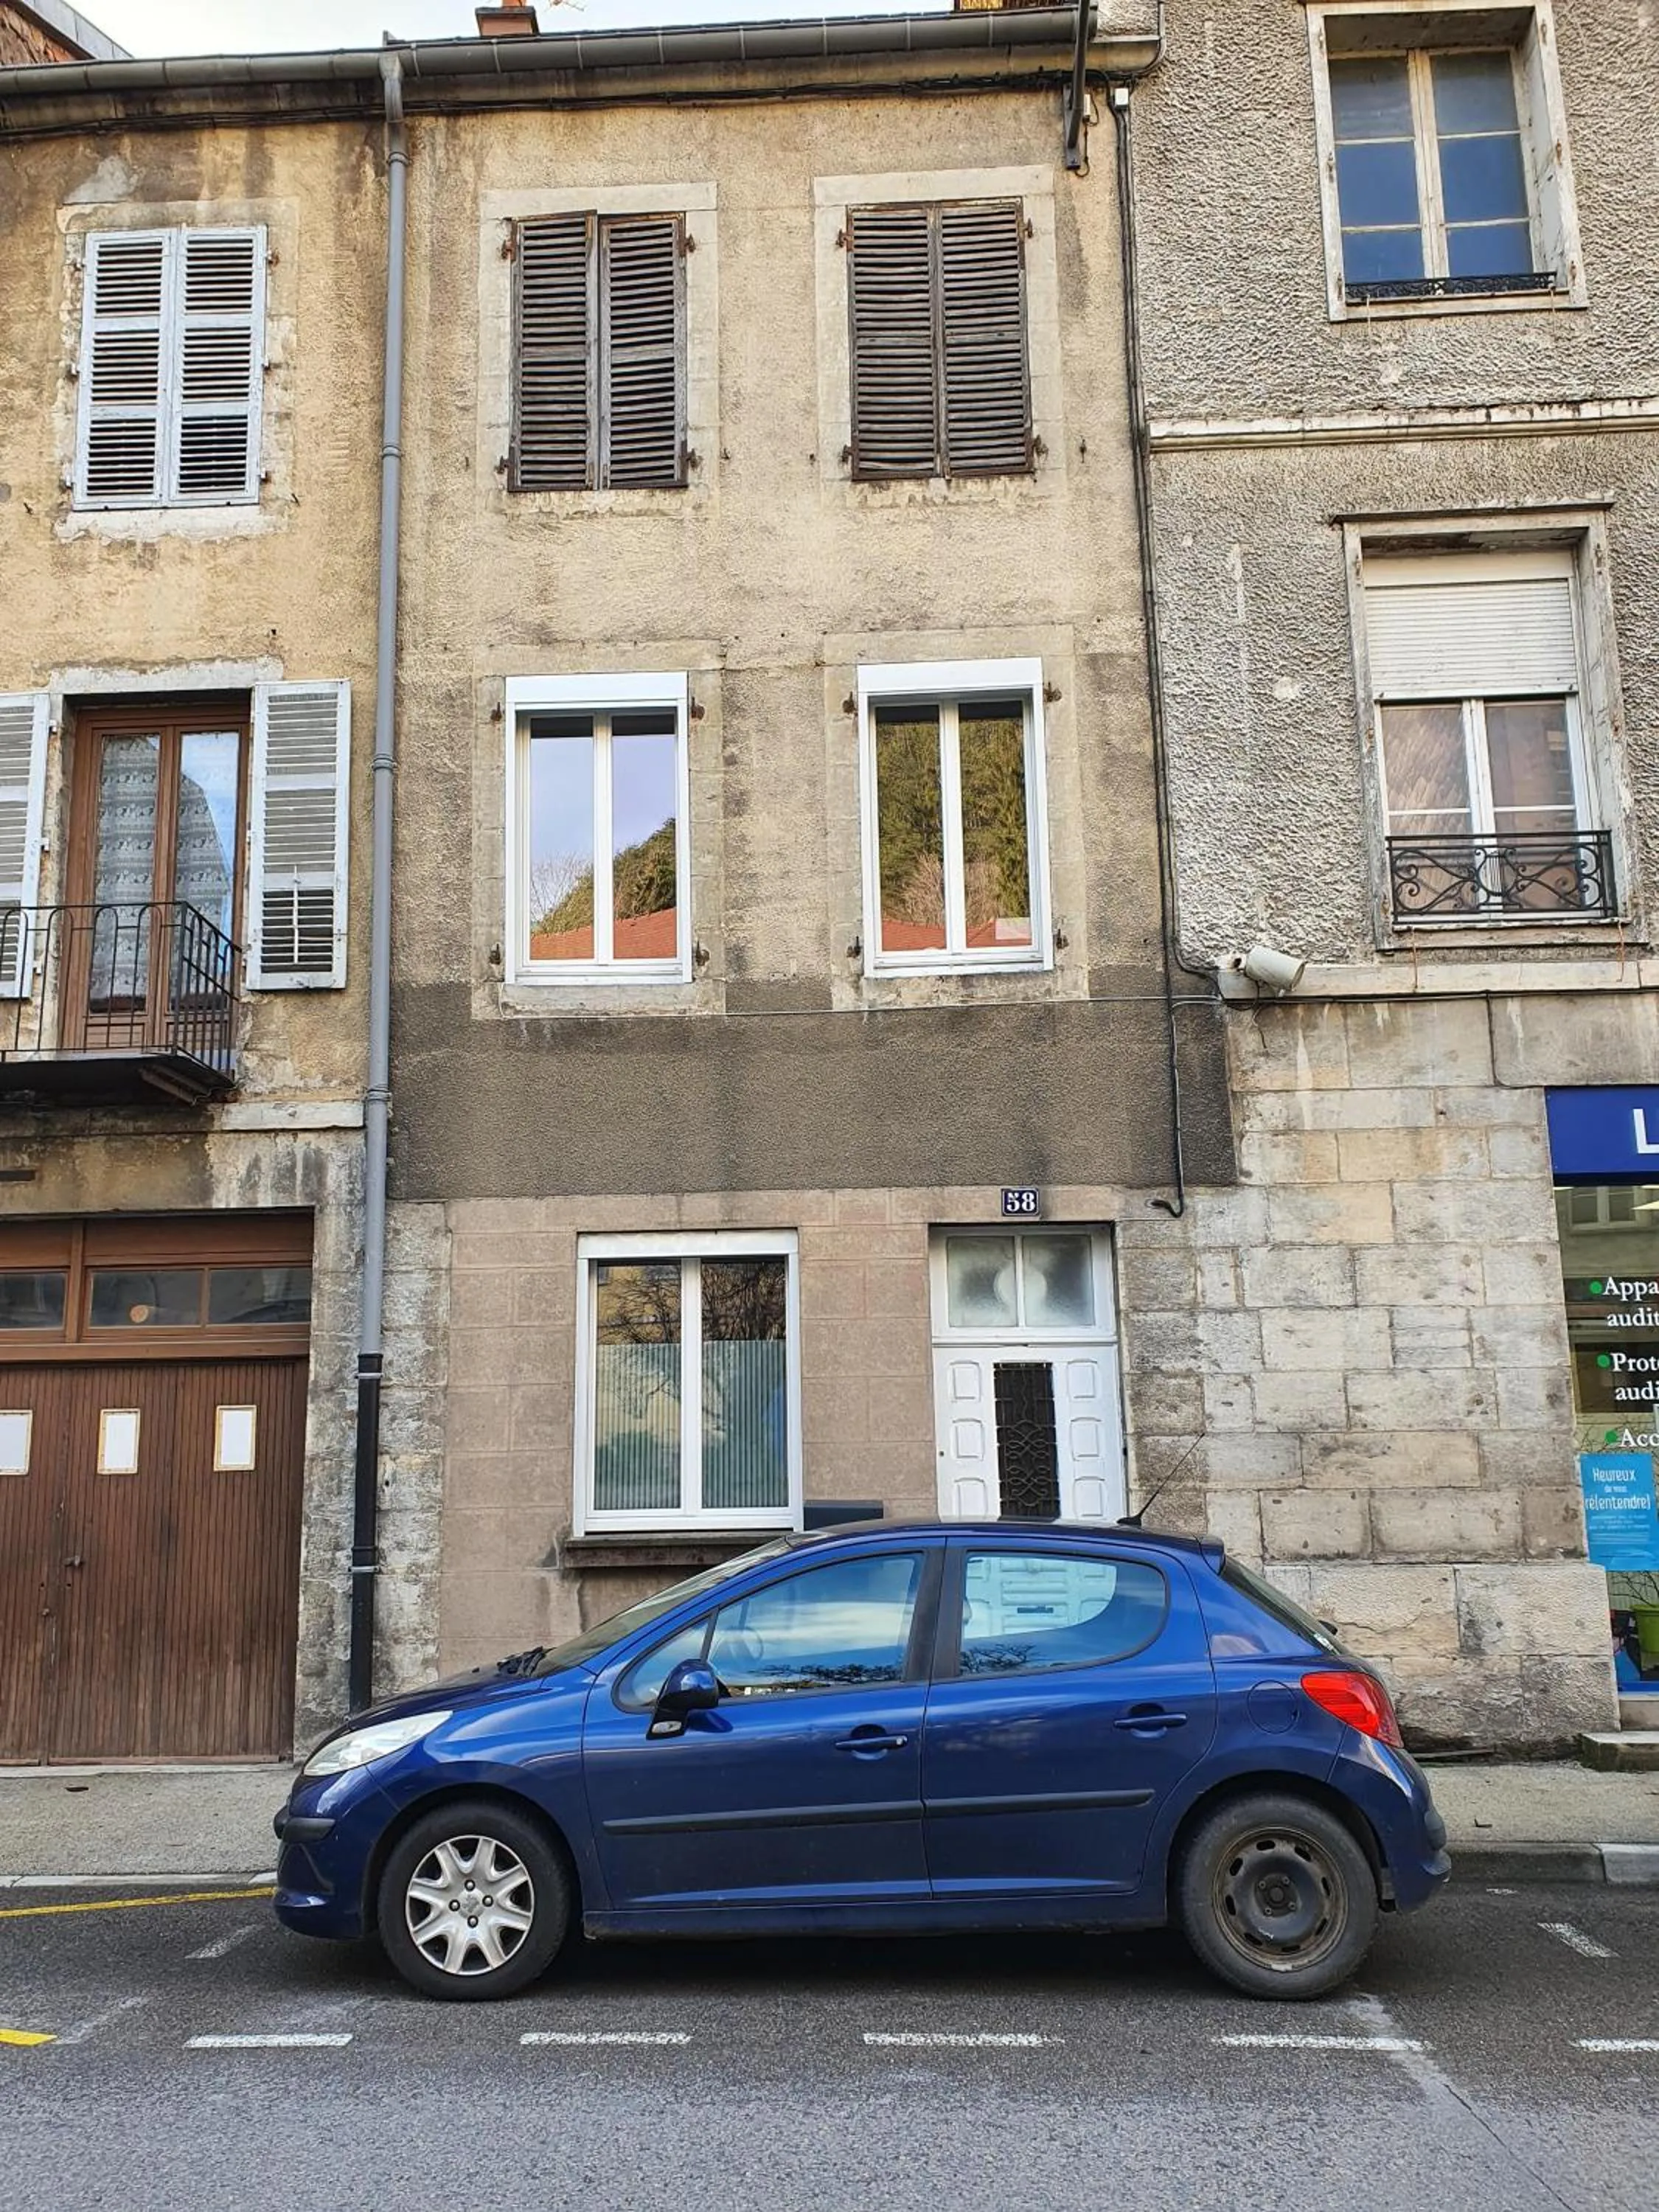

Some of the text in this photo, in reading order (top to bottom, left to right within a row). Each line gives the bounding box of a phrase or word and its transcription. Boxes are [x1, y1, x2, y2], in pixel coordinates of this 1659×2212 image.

[1006, 1192, 1035, 1212] 58
[1610, 1352, 1659, 1372] Prot
[1593, 1467, 1636, 1482] Heureux
